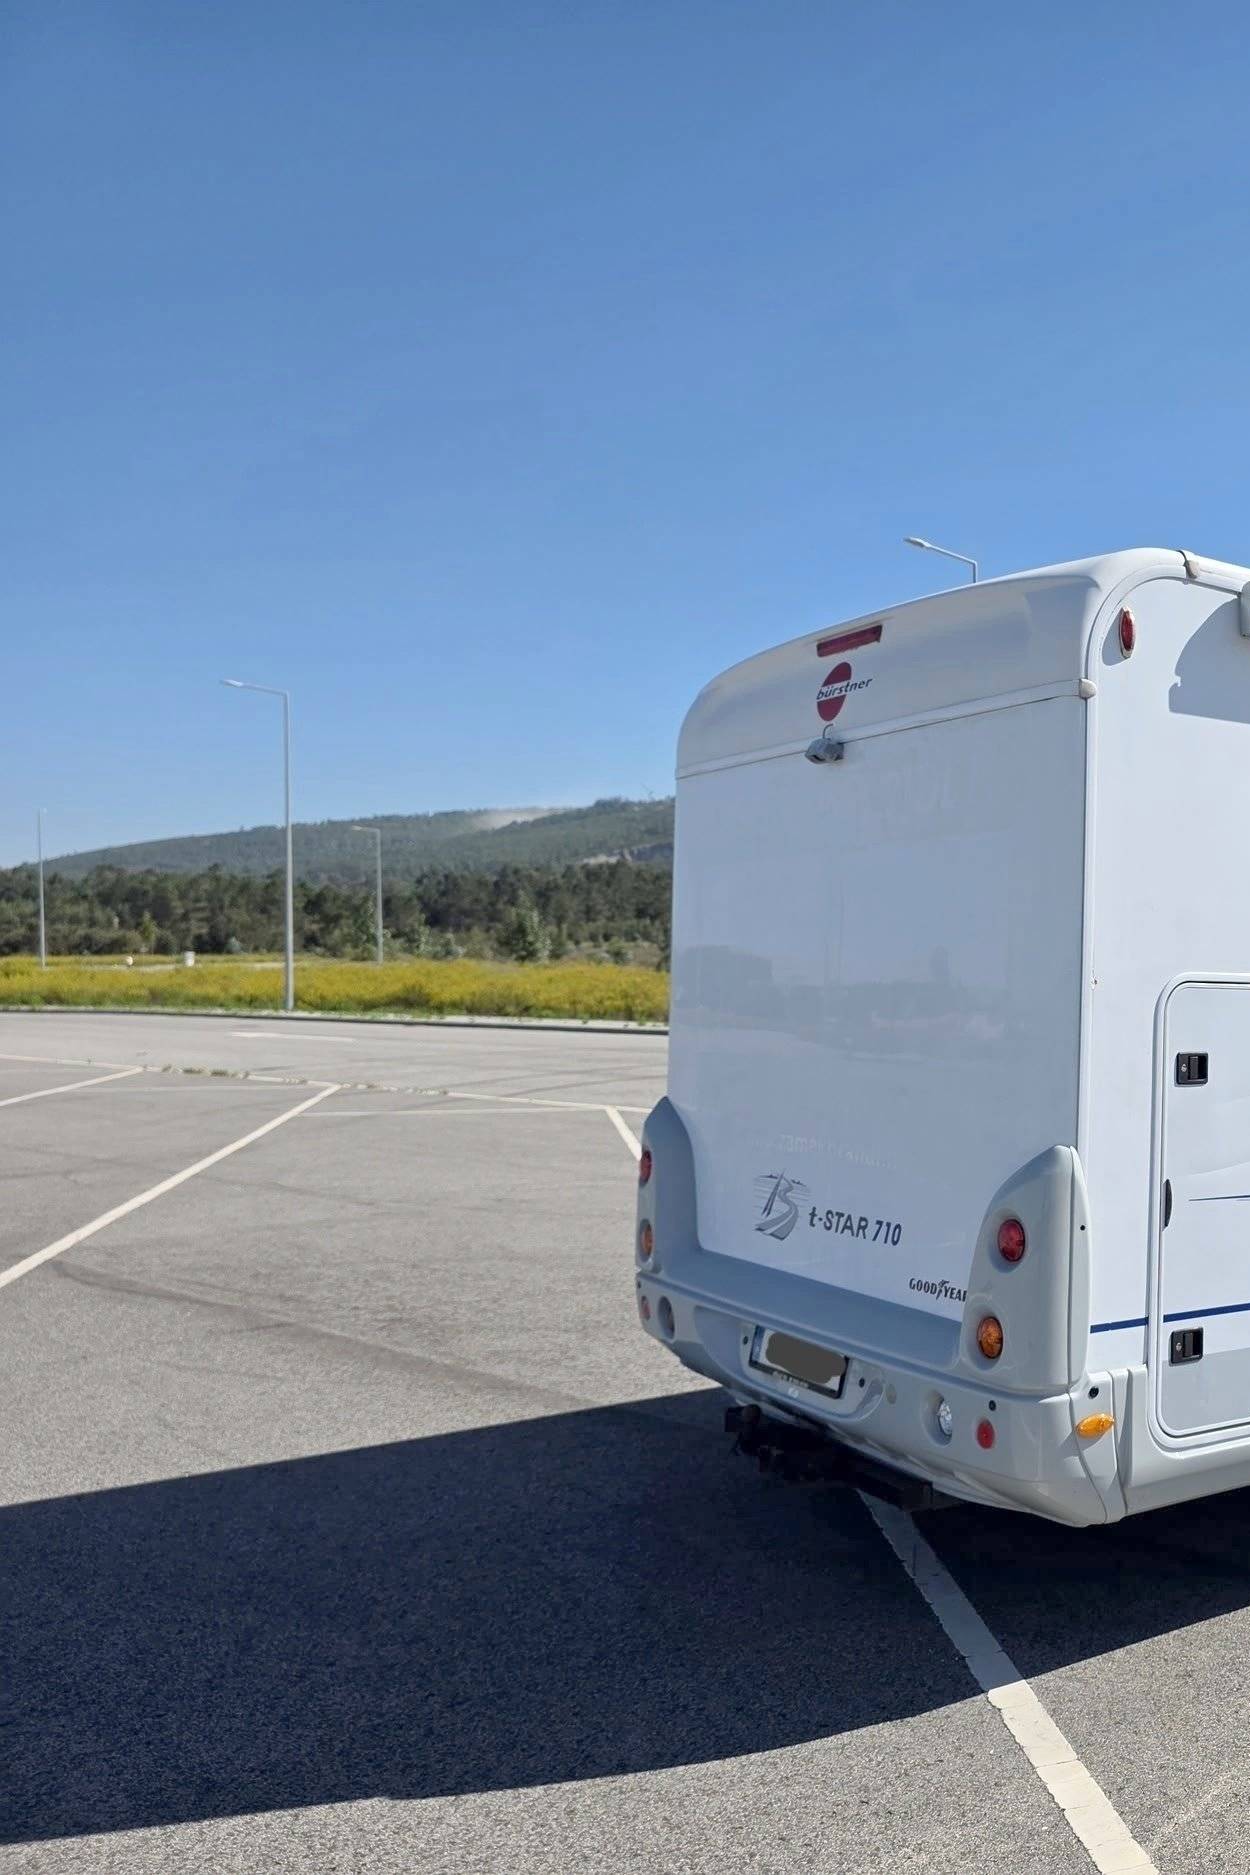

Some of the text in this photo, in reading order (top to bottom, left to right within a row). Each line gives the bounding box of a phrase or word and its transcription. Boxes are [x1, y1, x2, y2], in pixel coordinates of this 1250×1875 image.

[816, 679, 873, 700] bürstner
[809, 1206, 902, 1246] t-STAR 710
